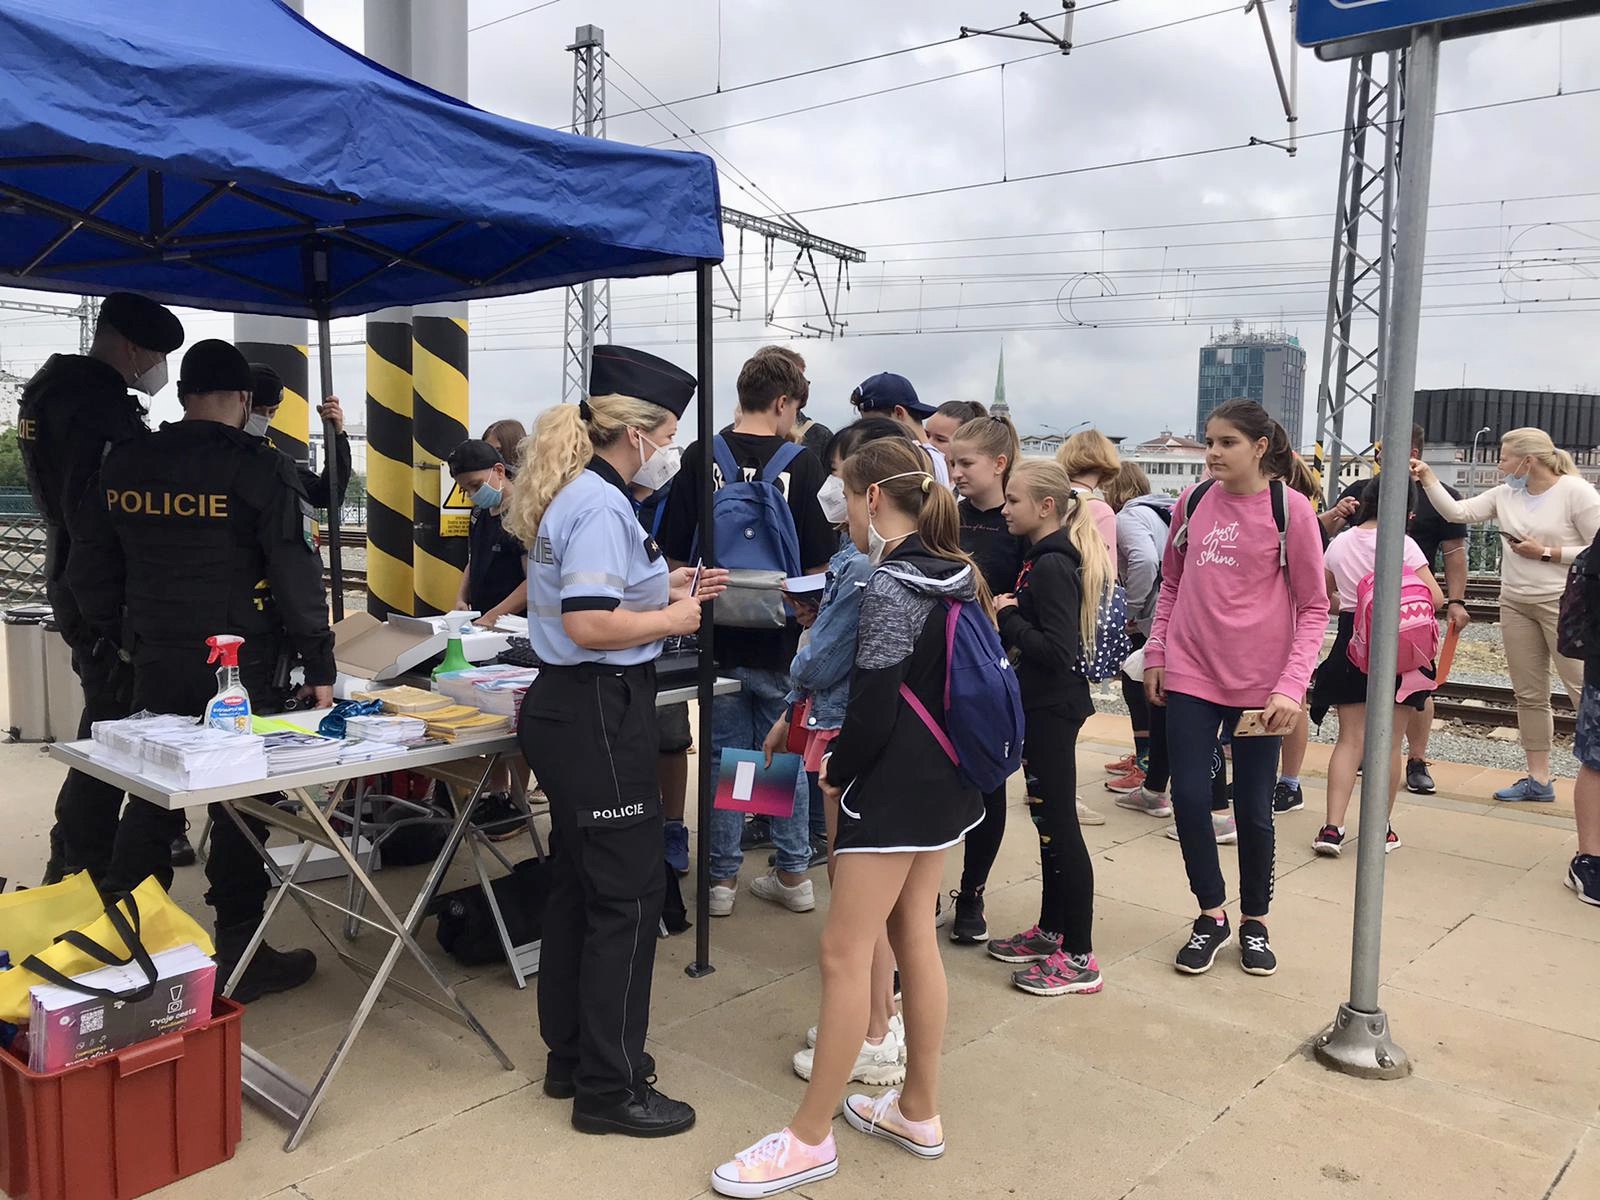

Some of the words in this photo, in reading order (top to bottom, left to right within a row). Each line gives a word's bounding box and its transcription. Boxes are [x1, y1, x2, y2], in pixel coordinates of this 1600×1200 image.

[106, 489, 228, 517] POLICIE
[1202, 520, 1240, 546] just
[592, 803, 644, 819] POLICIE
